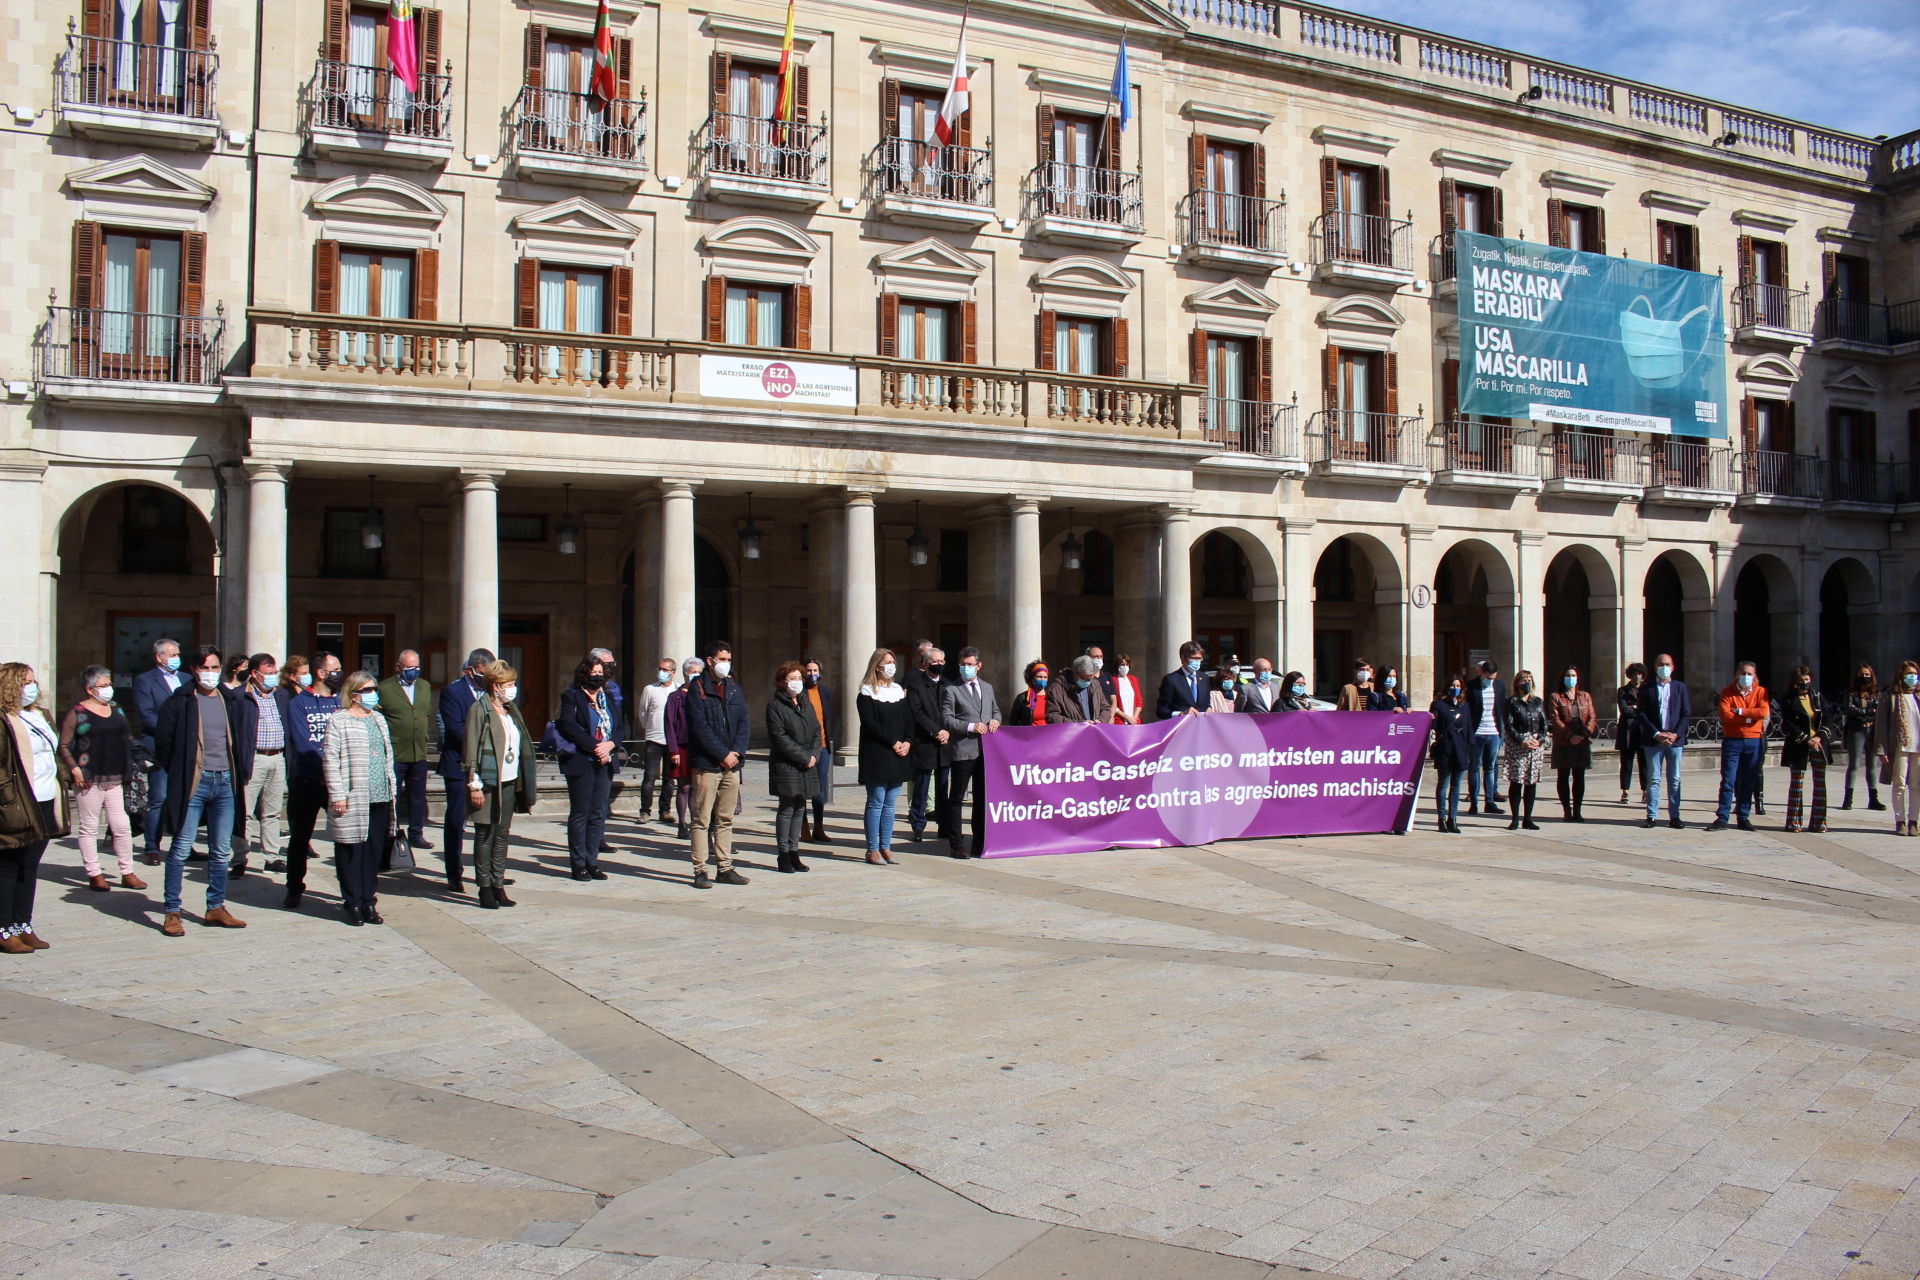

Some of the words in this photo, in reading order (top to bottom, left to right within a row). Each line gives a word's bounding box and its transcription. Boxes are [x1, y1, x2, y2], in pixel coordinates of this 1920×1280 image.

[1472, 246, 1502, 262] Zugatik.
[1504, 252, 1531, 267] Nigatik.
[1533, 257, 1591, 276] Errespetuagatik.
[1473, 265, 1563, 301] MASKARA
[1474, 289, 1543, 322] ERABILI
[1475, 325, 1514, 353] USA
[716, 369, 761, 378] MATXISTARIK
[742, 363, 764, 371] ERASO
[769, 367, 789, 379] EZ!
[1475, 350, 1589, 386] MASCARILLA
[795, 390, 831, 398] MACHISTAS!
[803, 382, 814, 390] LAS
[815, 384, 853, 392] AGRESIONES
[1476, 378, 1490, 391] Por
[1491, 379, 1499, 391] ti.
[1501, 380, 1513, 393] Por
[1515, 381, 1528, 394] mí.
[1529, 383, 1541, 396] Por
[1543, 386, 1573, 400] respeto.
[1545, 409, 1590, 422] #MaskaraBeti
[1595, 414, 1657, 429] #SiempreMascarilla
[306, 712, 332, 723] GEN
[1009, 755, 1173, 786] Vitoria-Gasteiz
[1179, 750, 1233, 771] eraso
[1239, 747, 1335, 768] matxisten
[1340, 745, 1401, 765] aurka
[988, 794, 1132, 823] Vitoria-Gasteiz
[1135, 787, 1201, 810] contra
[1204, 784, 1220, 804] las
[1224, 780, 1318, 806] agresiones
[1323, 777, 1415, 797] machistas
